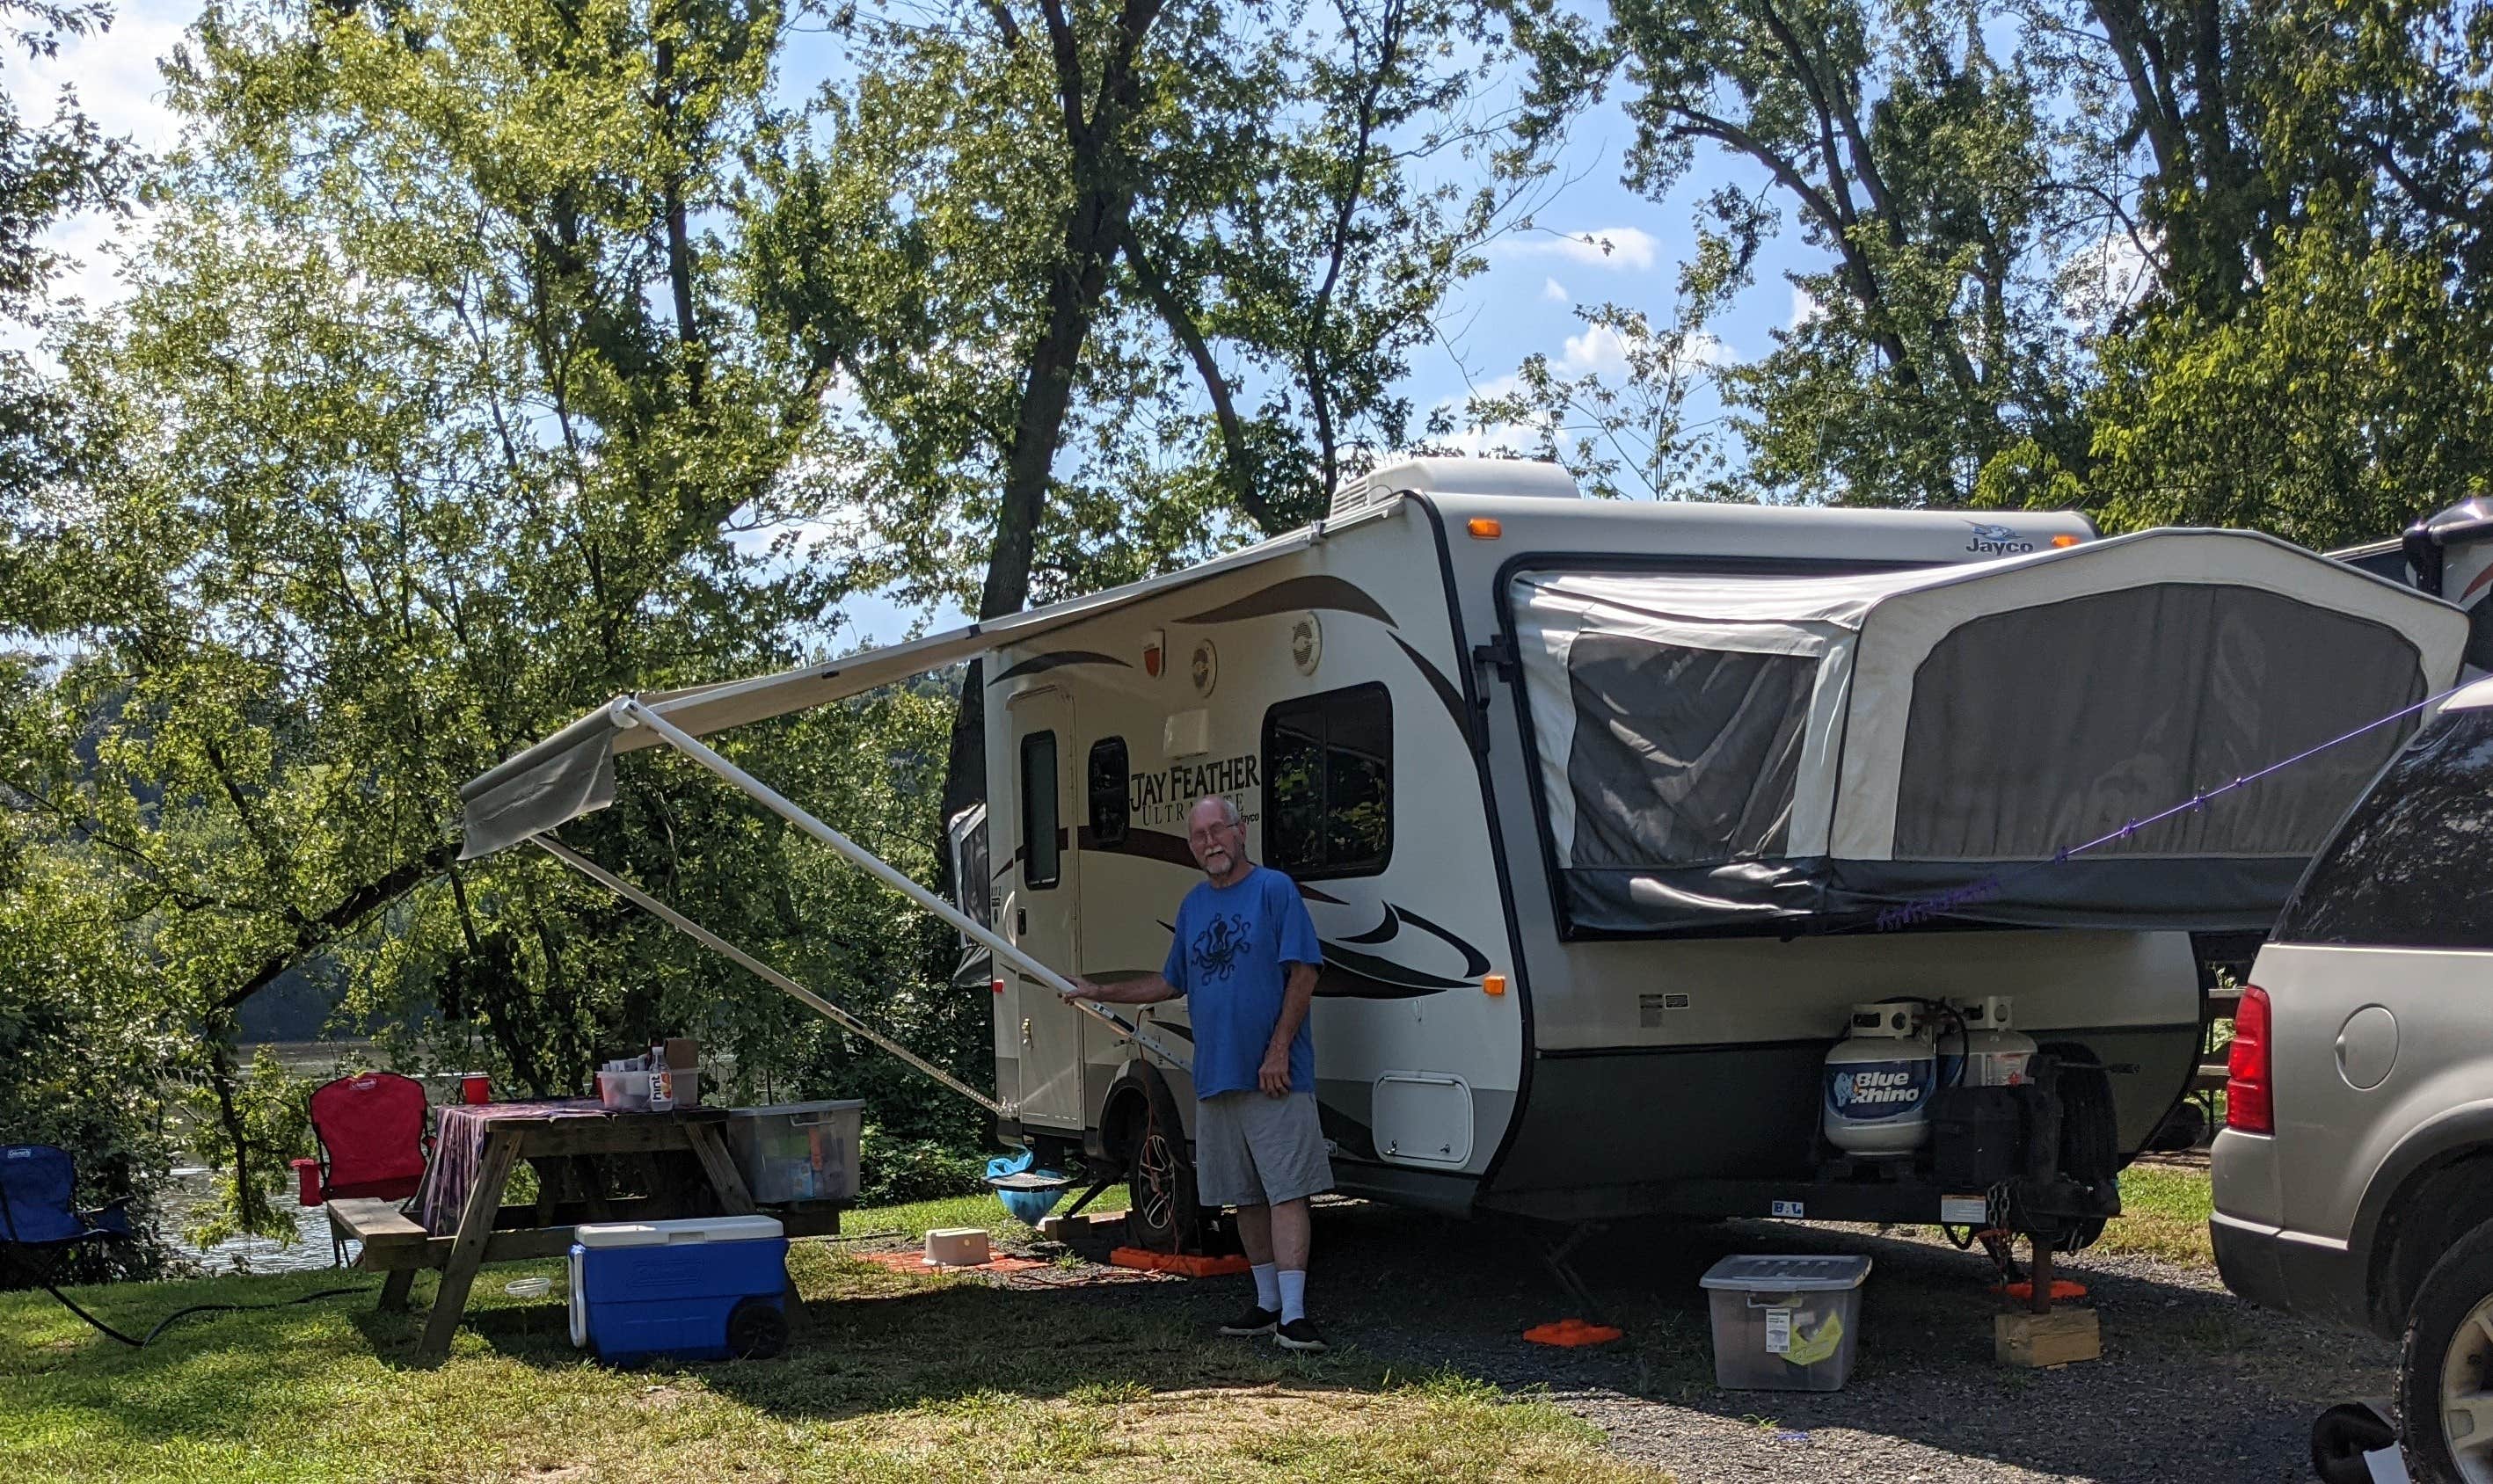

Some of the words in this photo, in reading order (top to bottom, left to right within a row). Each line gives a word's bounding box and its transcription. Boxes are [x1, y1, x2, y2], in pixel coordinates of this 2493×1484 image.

[1965, 538, 2034, 556] Jayco
[1129, 772, 1167, 812] JAY
[1170, 754, 1261, 801] FEATHER
[1142, 801, 1193, 826] ULTR
[651, 1074, 662, 1101] hint
[1855, 1071, 1910, 1088] Blue
[1849, 1086, 1920, 1104] Rhino
[1773, 1202, 1802, 1214] BL
